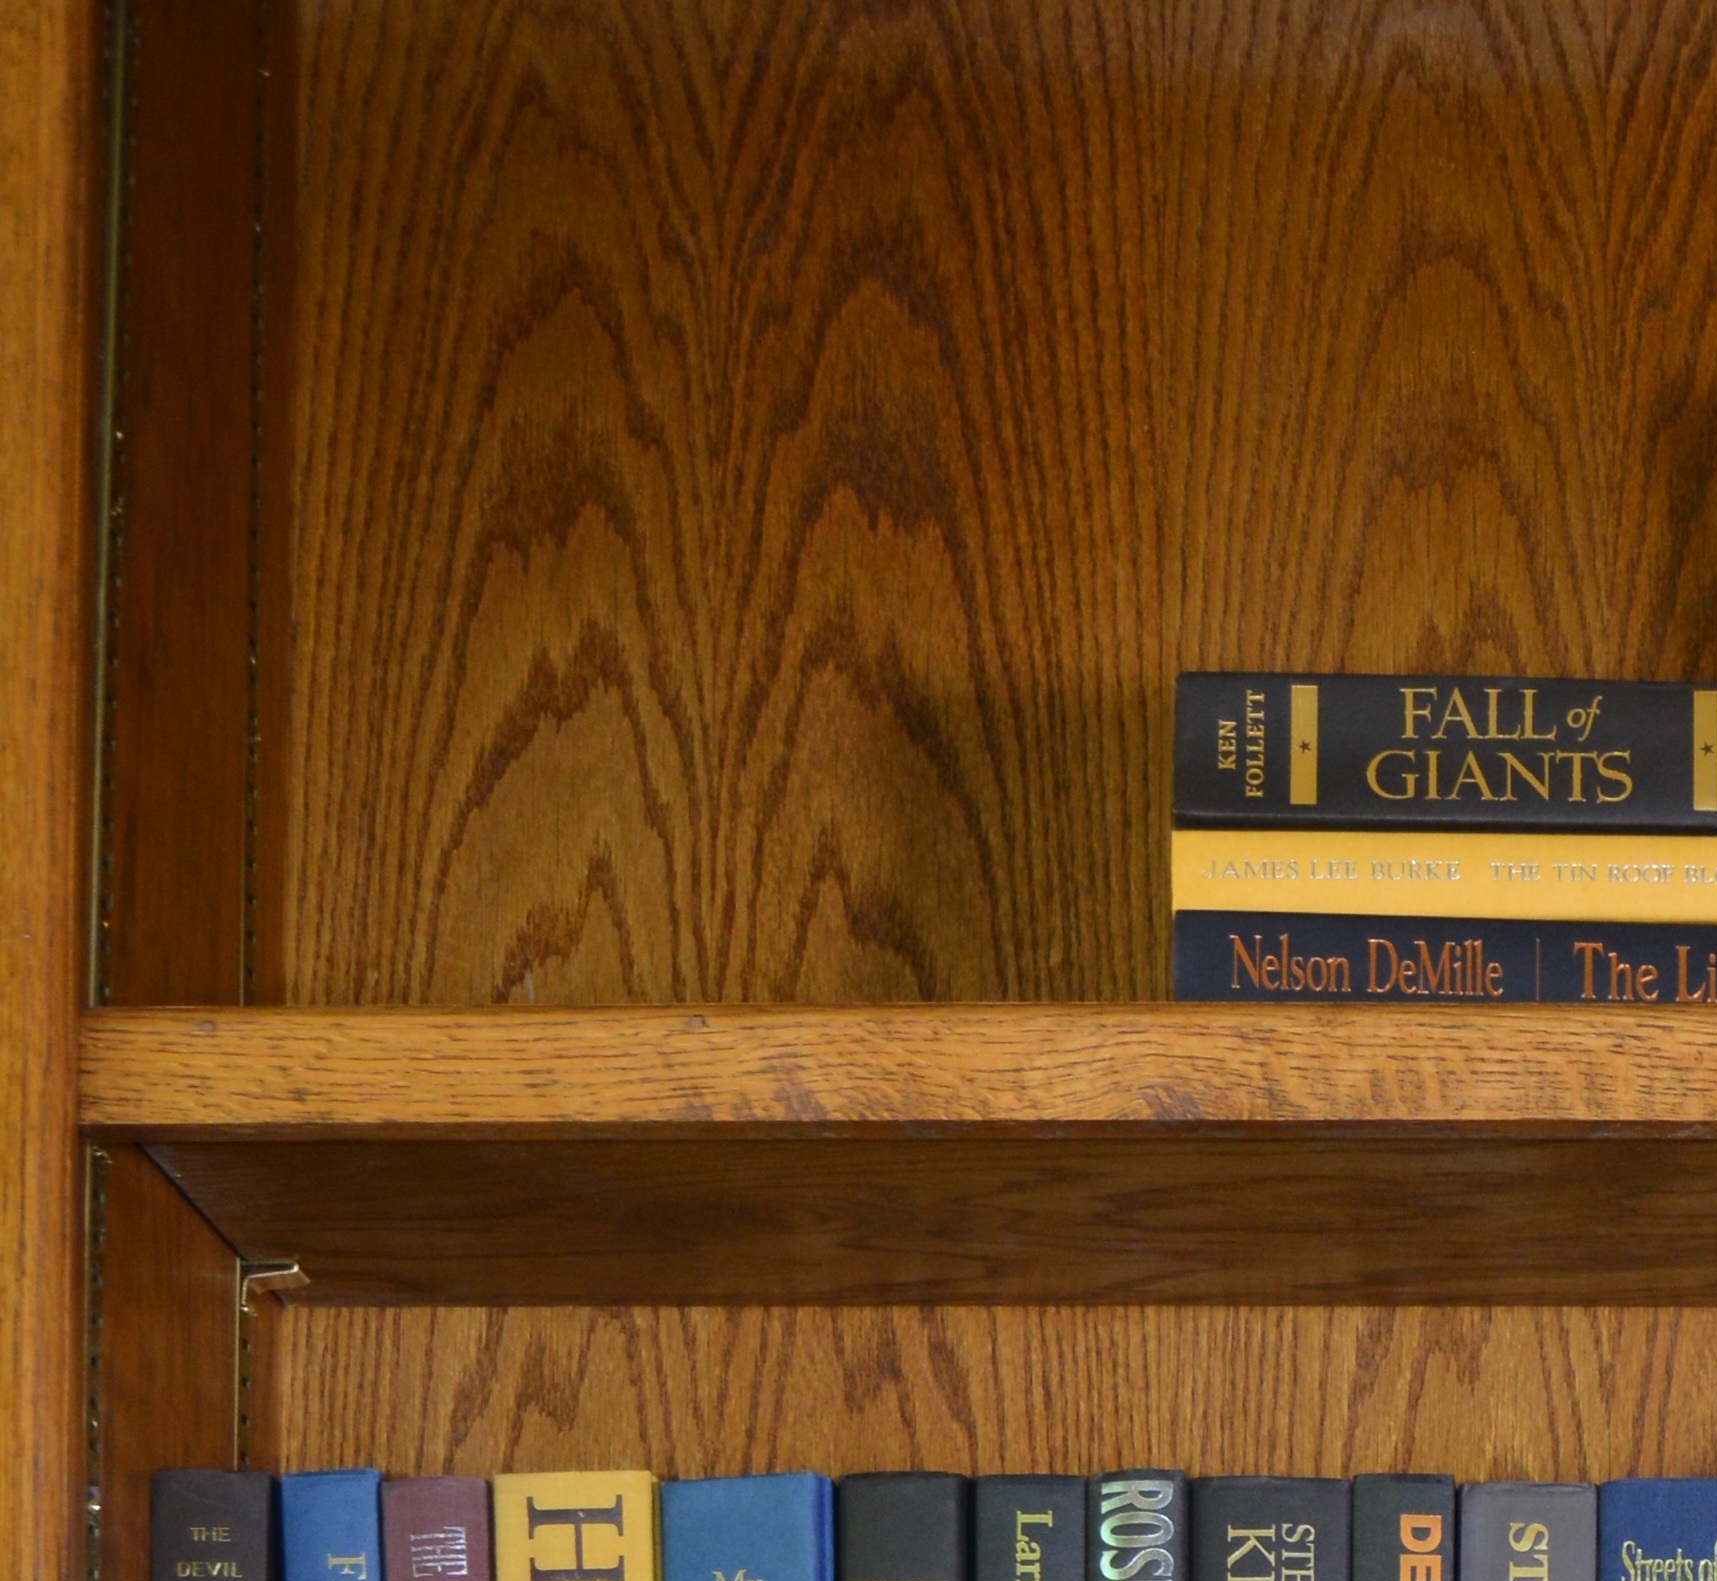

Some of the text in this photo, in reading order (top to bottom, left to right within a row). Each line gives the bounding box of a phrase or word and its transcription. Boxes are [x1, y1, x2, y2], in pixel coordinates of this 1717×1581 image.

[1399, 687, 1602, 741] FALL of
[1218, 720, 1236, 769] KEN
[1246, 690, 1264, 796] FOLLETT
[1366, 750, 1632, 803] GIANTS
[1229, 933, 1351, 992] Nelson
[1367, 938, 1503, 997] DeMille
[1573, 942, 1662, 1000] The
